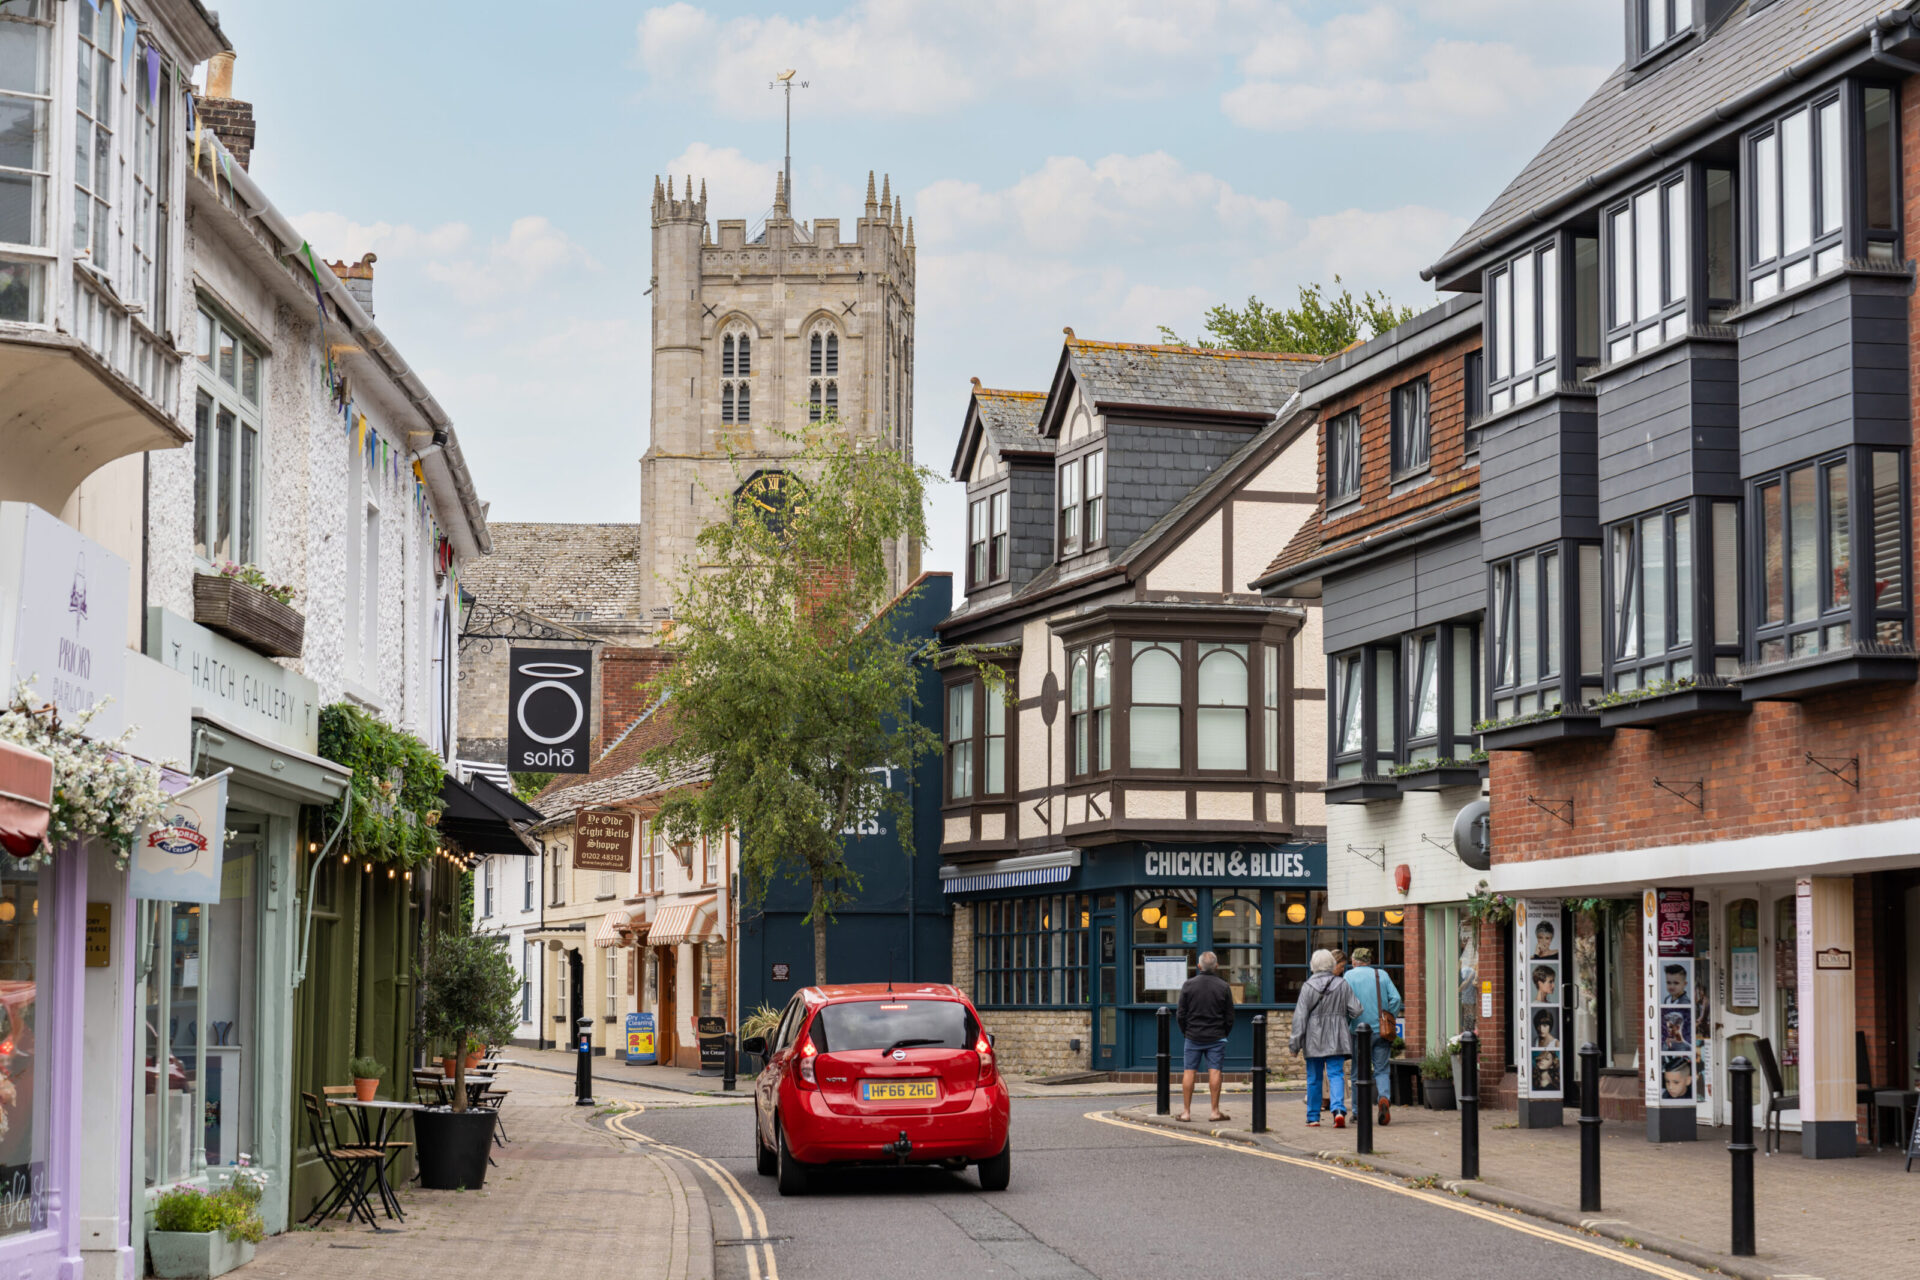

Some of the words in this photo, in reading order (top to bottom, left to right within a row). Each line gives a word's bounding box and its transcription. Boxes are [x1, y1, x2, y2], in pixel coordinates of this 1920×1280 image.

[58, 637, 90, 680] PRIORY
[193, 651, 235, 701] HATCH
[243, 674, 295, 725] GALLERY
[587, 814, 600, 825] Ye
[601, 816, 623, 825] Olde
[579, 826, 603, 838] Eight
[604, 828, 630, 838] Bells
[586, 839, 620, 850] Shoppe
[581, 852, 600, 860] 01202
[1145, 852, 1225, 876] CHICKEN
[871, 1084, 905, 1098] HF66
[908, 1083, 934, 1097] ZHG
